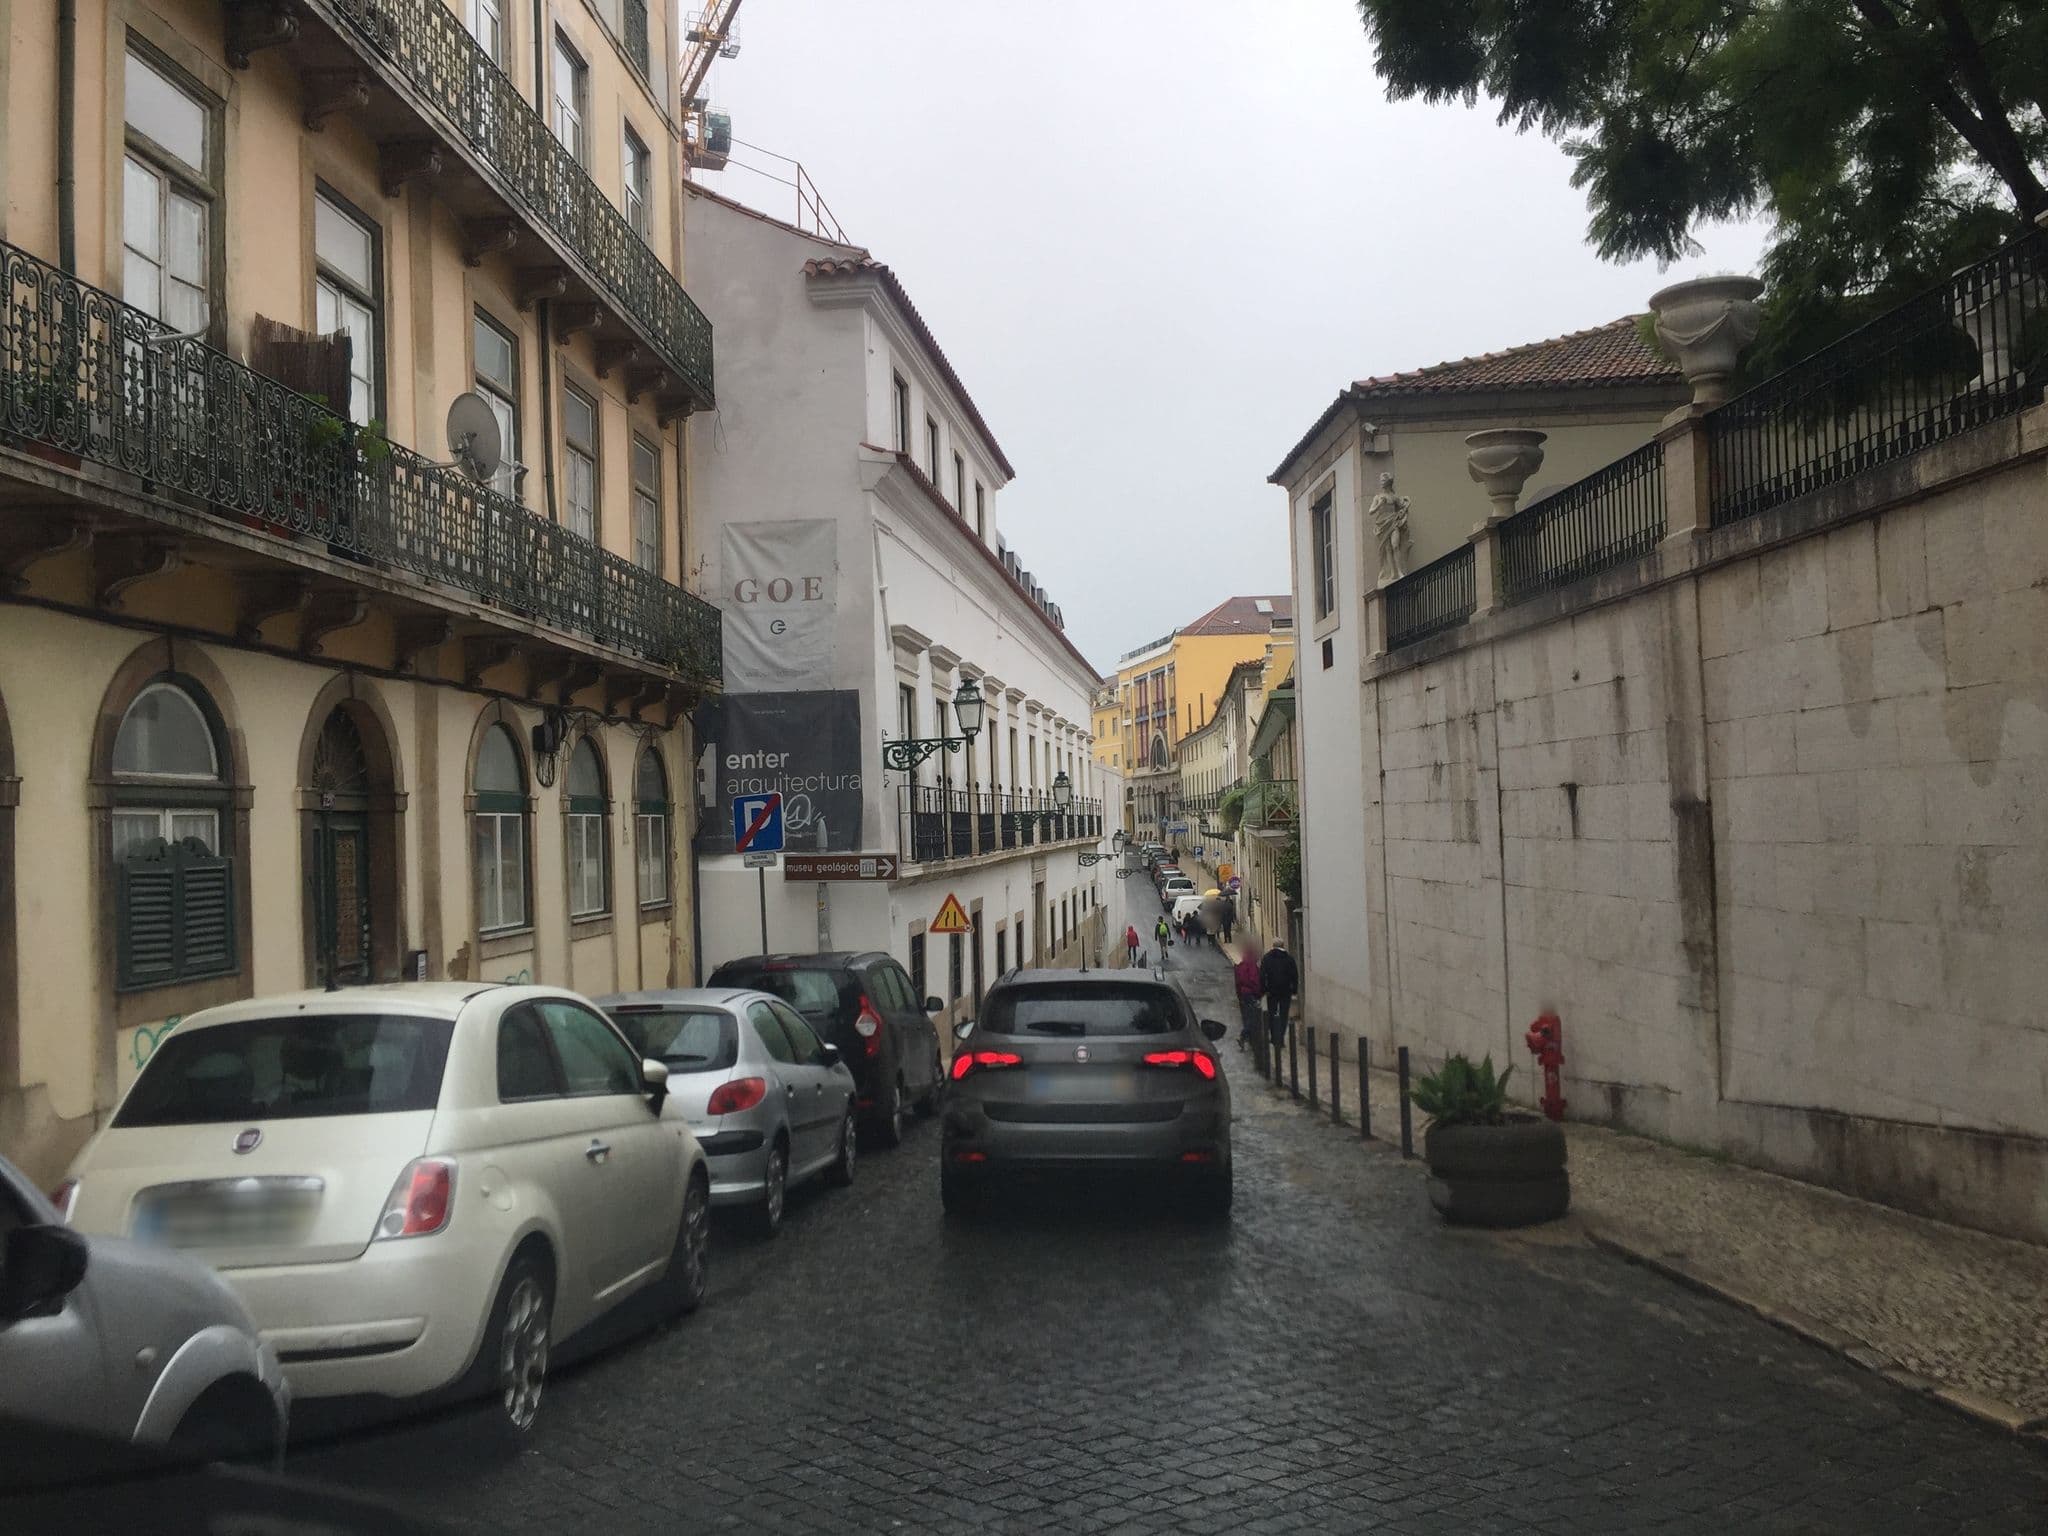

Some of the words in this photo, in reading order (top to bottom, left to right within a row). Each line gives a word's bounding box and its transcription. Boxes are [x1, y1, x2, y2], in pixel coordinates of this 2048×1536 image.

[734, 576, 824, 604] GOE
[725, 749, 790, 770] enter
[726, 771, 862, 794] arquitectura
[786, 863, 813, 873] museu
[816, 861, 860, 874] geológico
